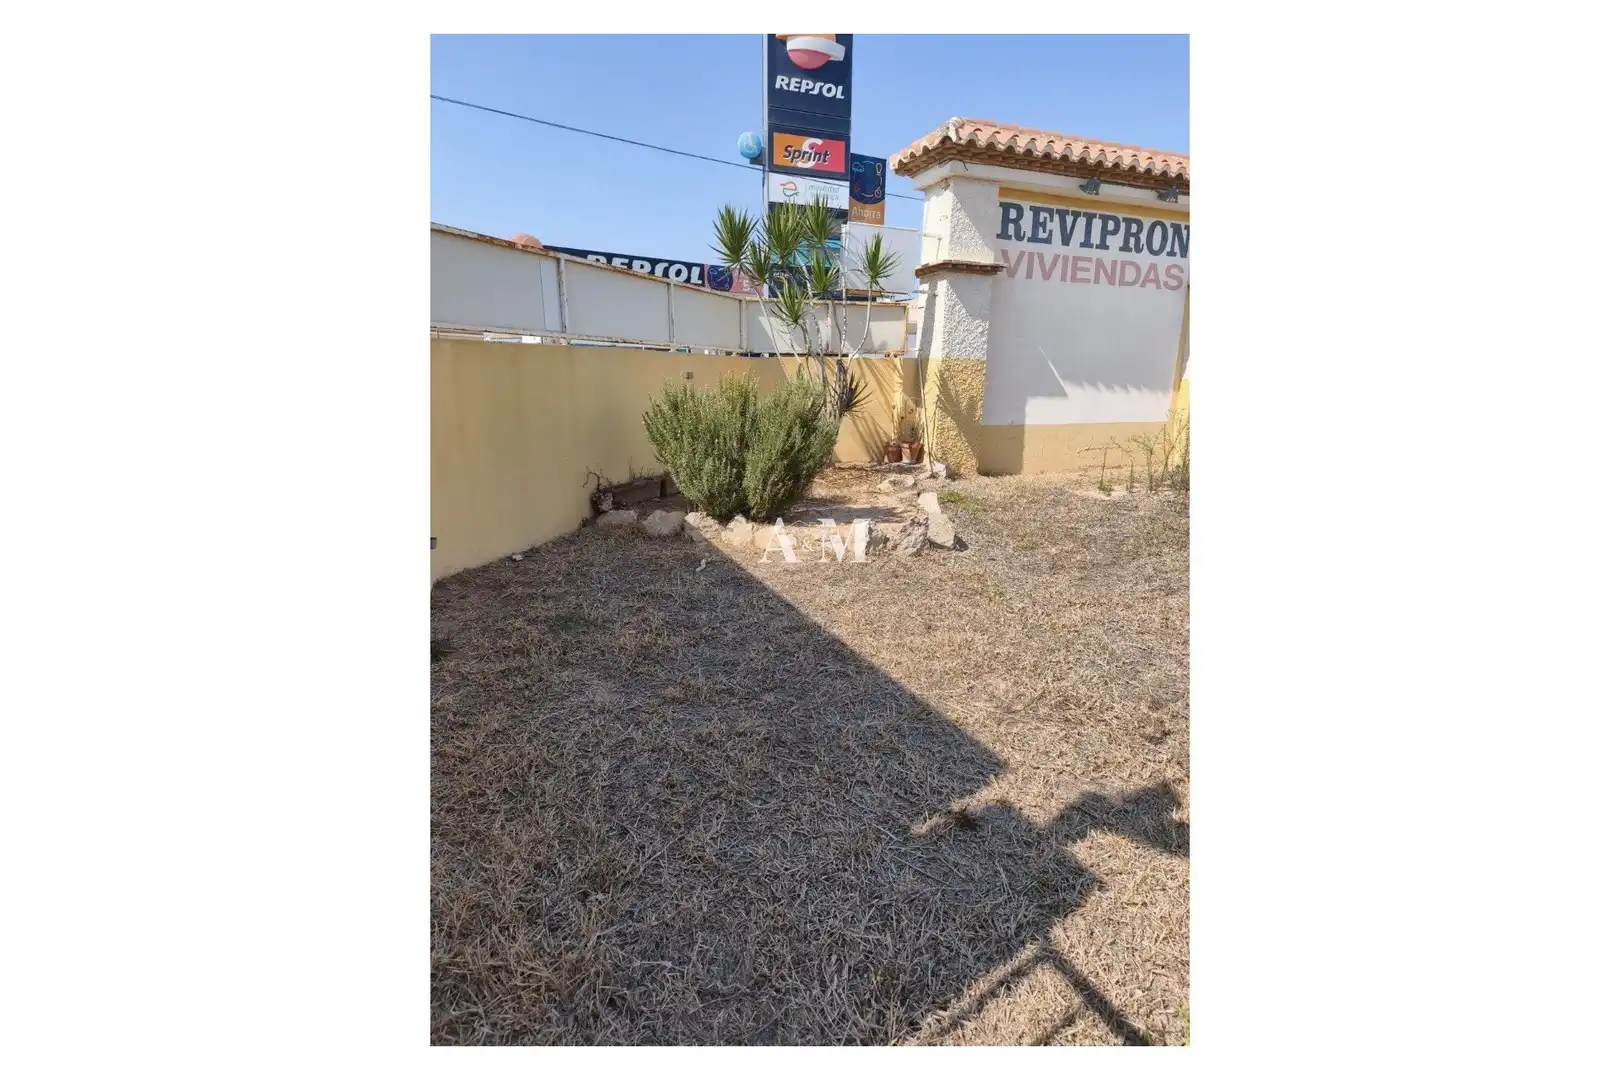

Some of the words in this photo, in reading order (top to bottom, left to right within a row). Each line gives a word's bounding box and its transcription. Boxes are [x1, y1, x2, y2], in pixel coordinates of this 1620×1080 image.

[775, 75, 845, 99] REPSOL
[783, 145, 830, 164] Sprint
[851, 206, 881, 219] Ahorra
[996, 200, 1190, 258] REVIPRON
[1001, 248, 1184, 291] VIVIENDAS
